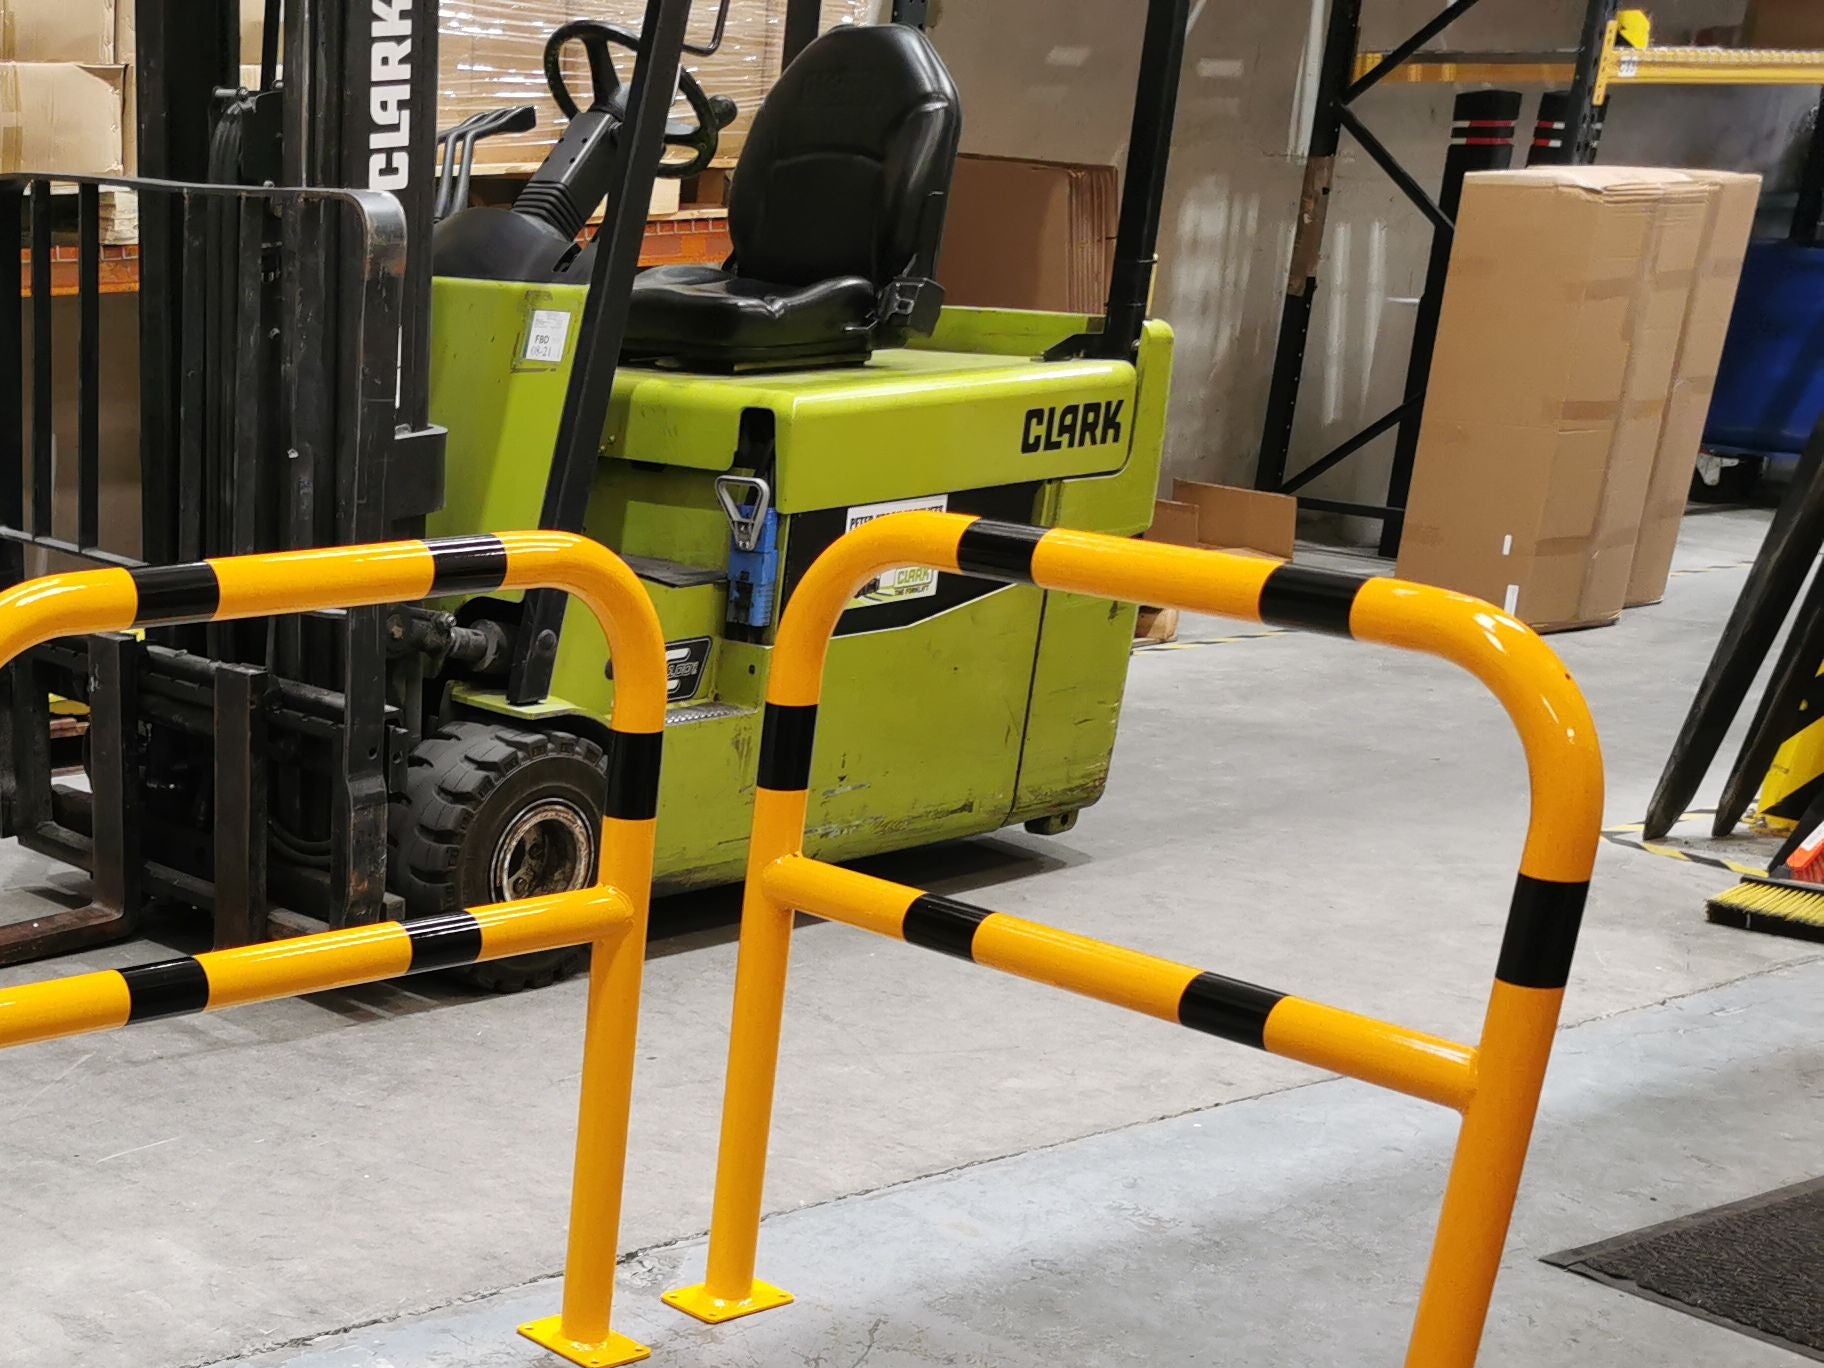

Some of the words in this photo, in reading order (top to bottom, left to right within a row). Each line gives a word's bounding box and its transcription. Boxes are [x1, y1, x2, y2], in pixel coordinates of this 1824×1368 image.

[368, 0, 413, 191] CLARK
[1020, 399, 1125, 455] CLARK
[897, 567, 930, 585] CLARK
